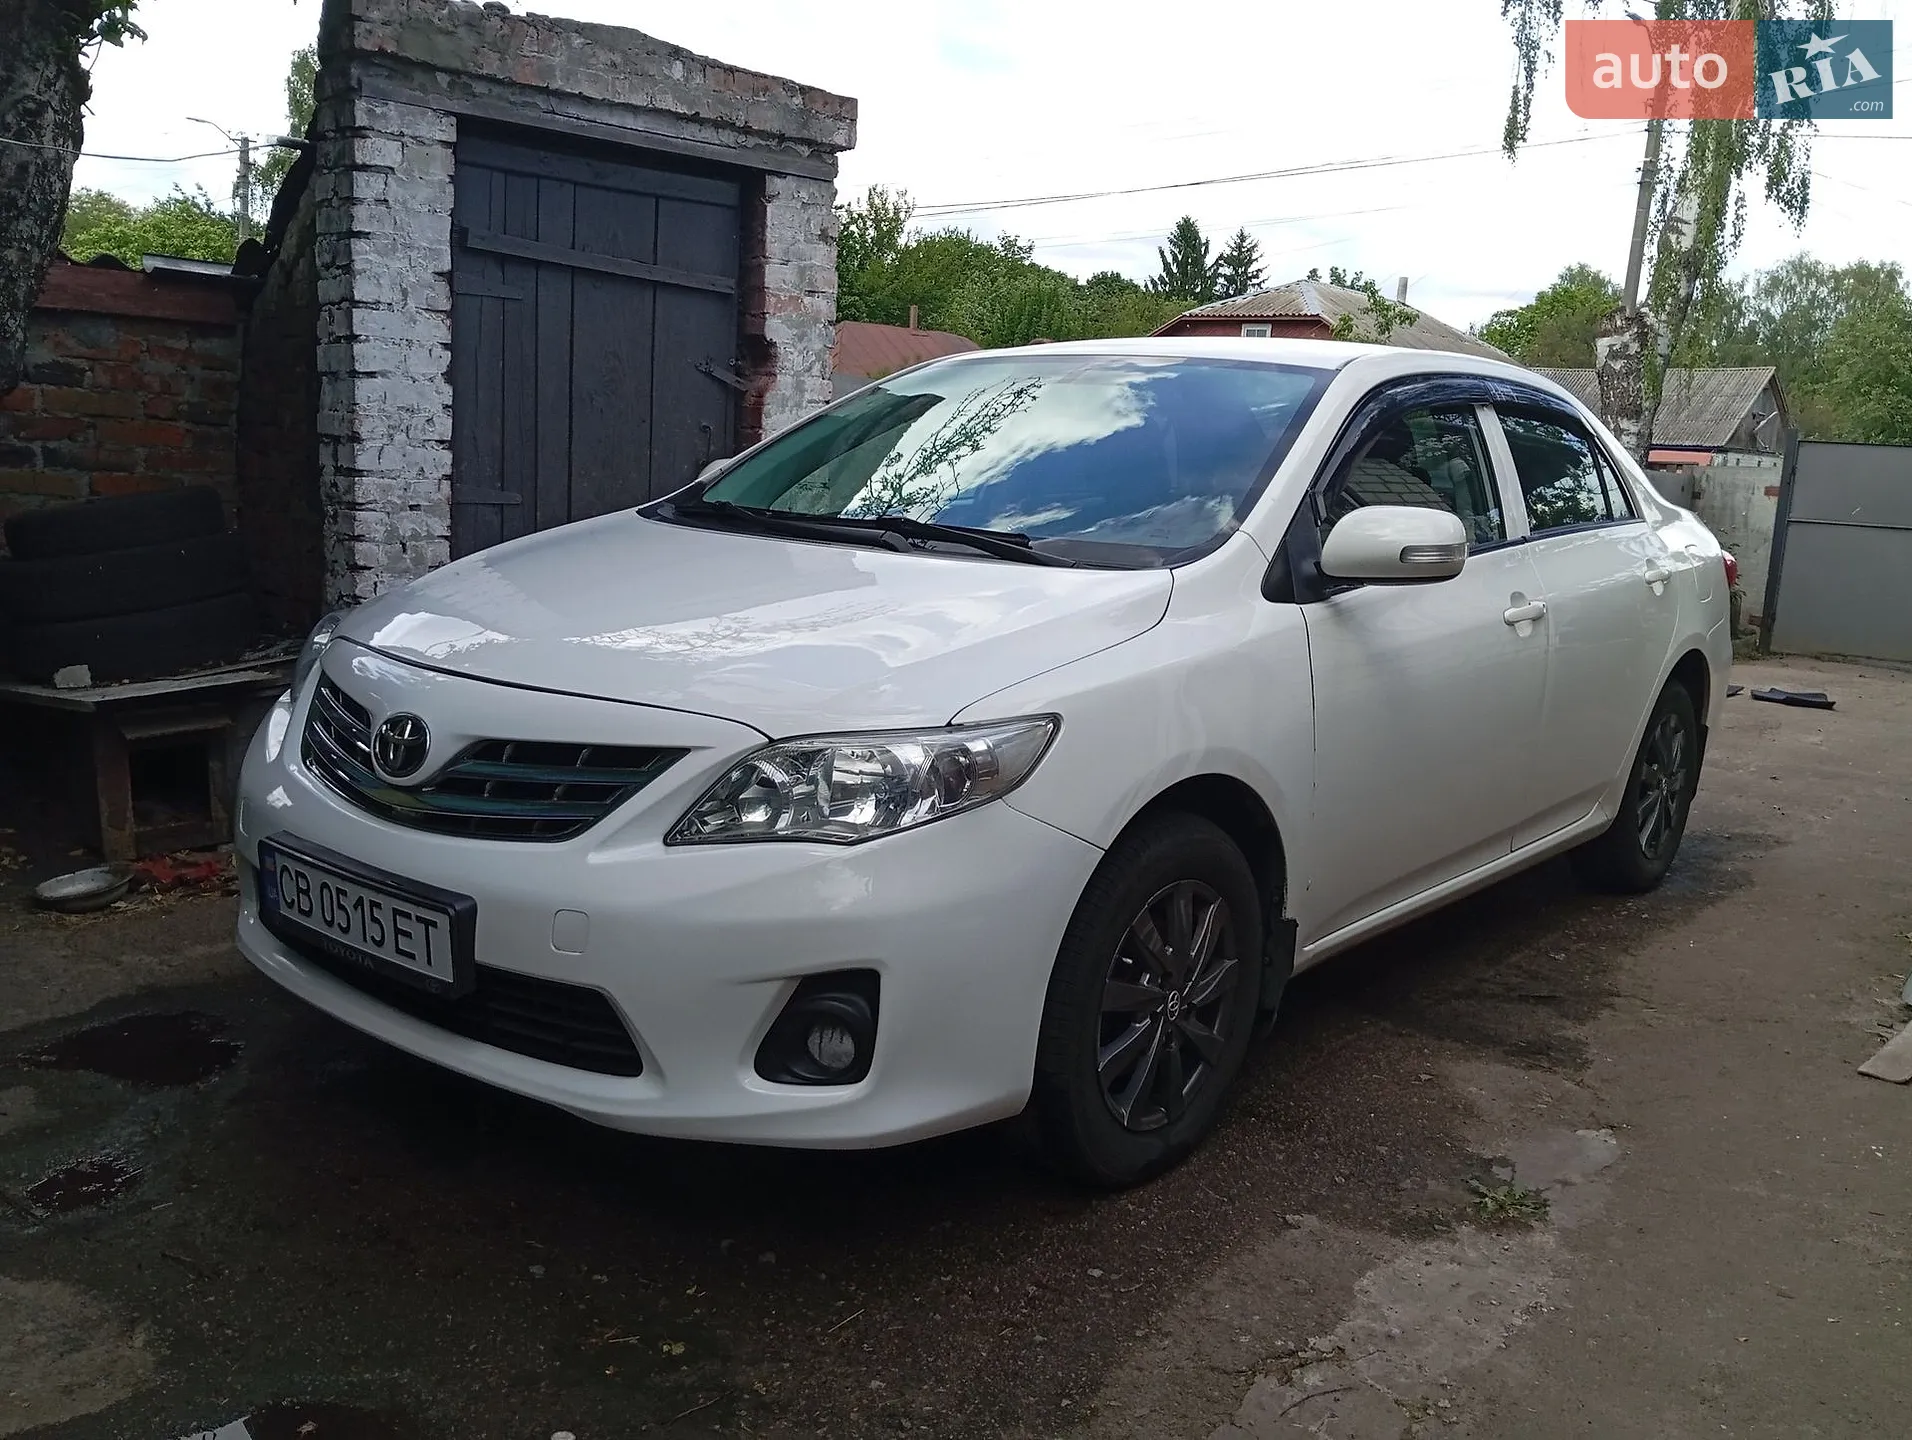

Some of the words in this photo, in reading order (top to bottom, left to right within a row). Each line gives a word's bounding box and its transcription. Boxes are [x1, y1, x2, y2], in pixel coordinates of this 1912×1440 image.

[279, 864, 313, 918] CB
[320, 881, 386, 948] 0515
[392, 906, 438, 967] ET
[323, 940, 374, 969] TOYOTA
